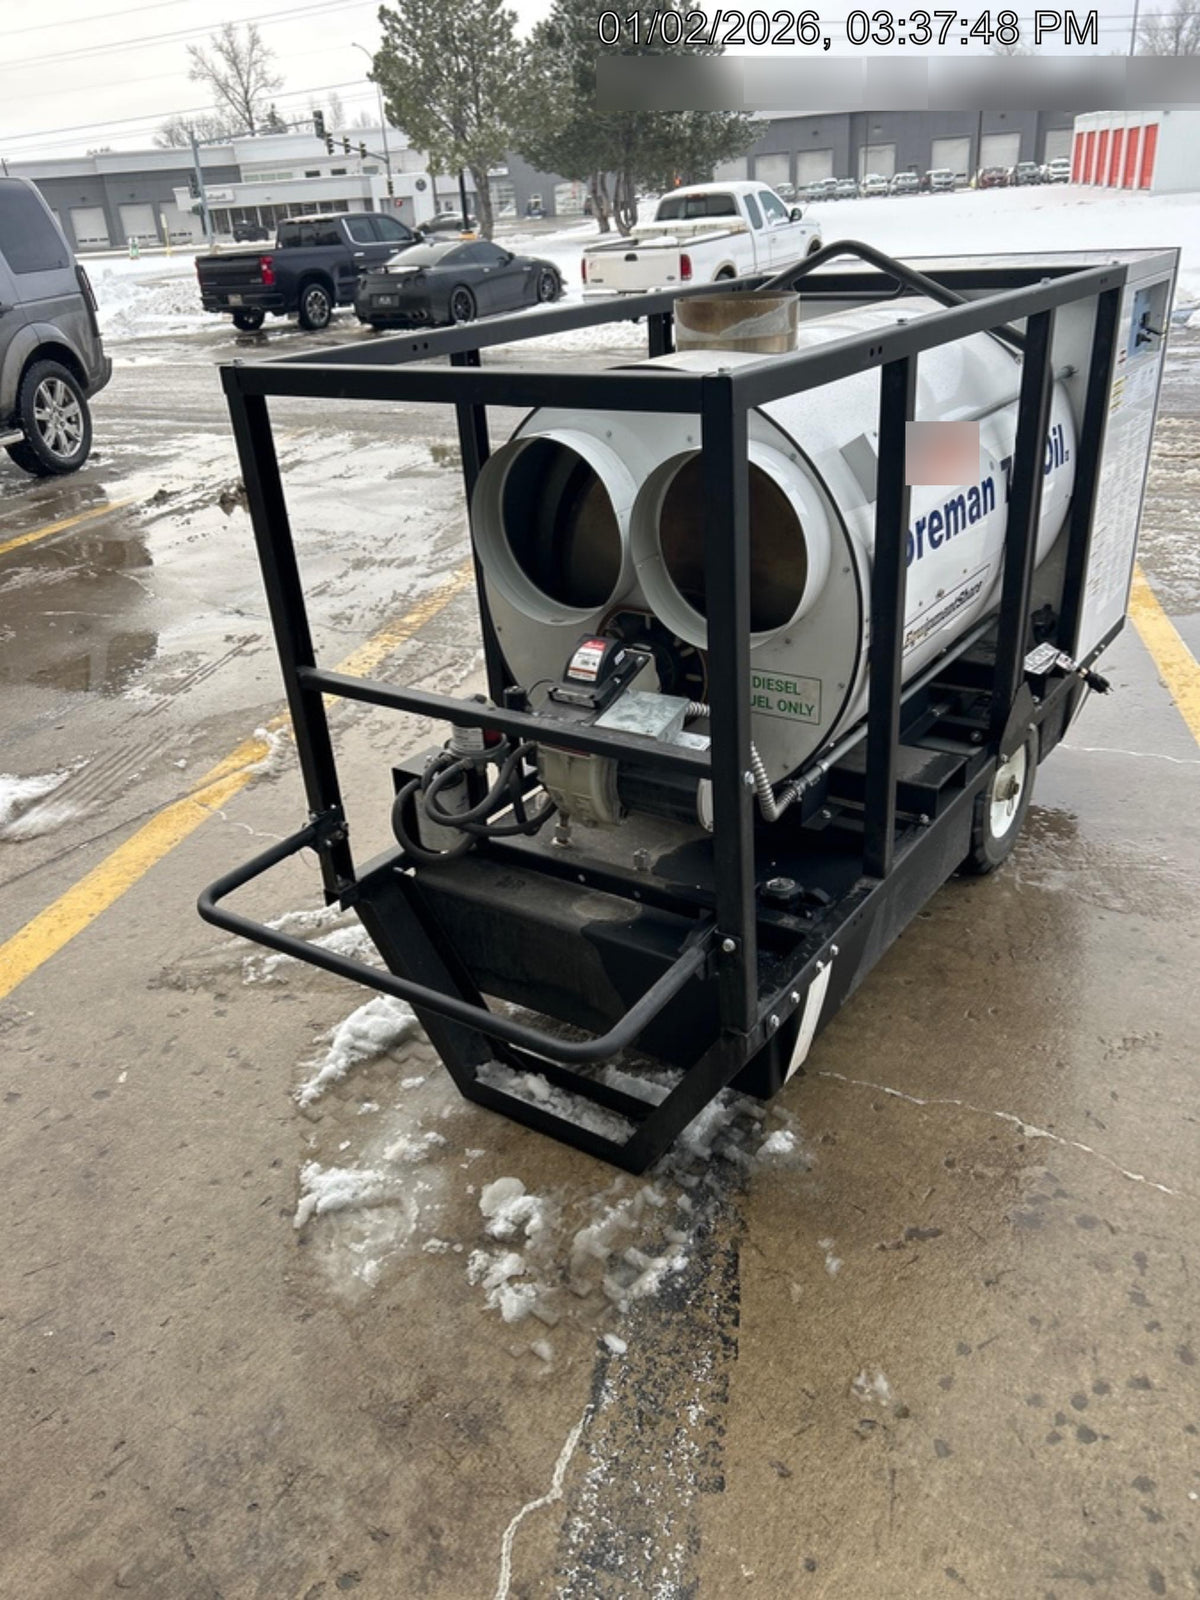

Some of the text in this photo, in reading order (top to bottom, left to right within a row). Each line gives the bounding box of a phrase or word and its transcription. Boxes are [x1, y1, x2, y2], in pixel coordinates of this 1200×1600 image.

[905, 476, 995, 568] oreman
[752, 675, 801, 696] DIESEL
[750, 694, 815, 717] UEL ONLY
